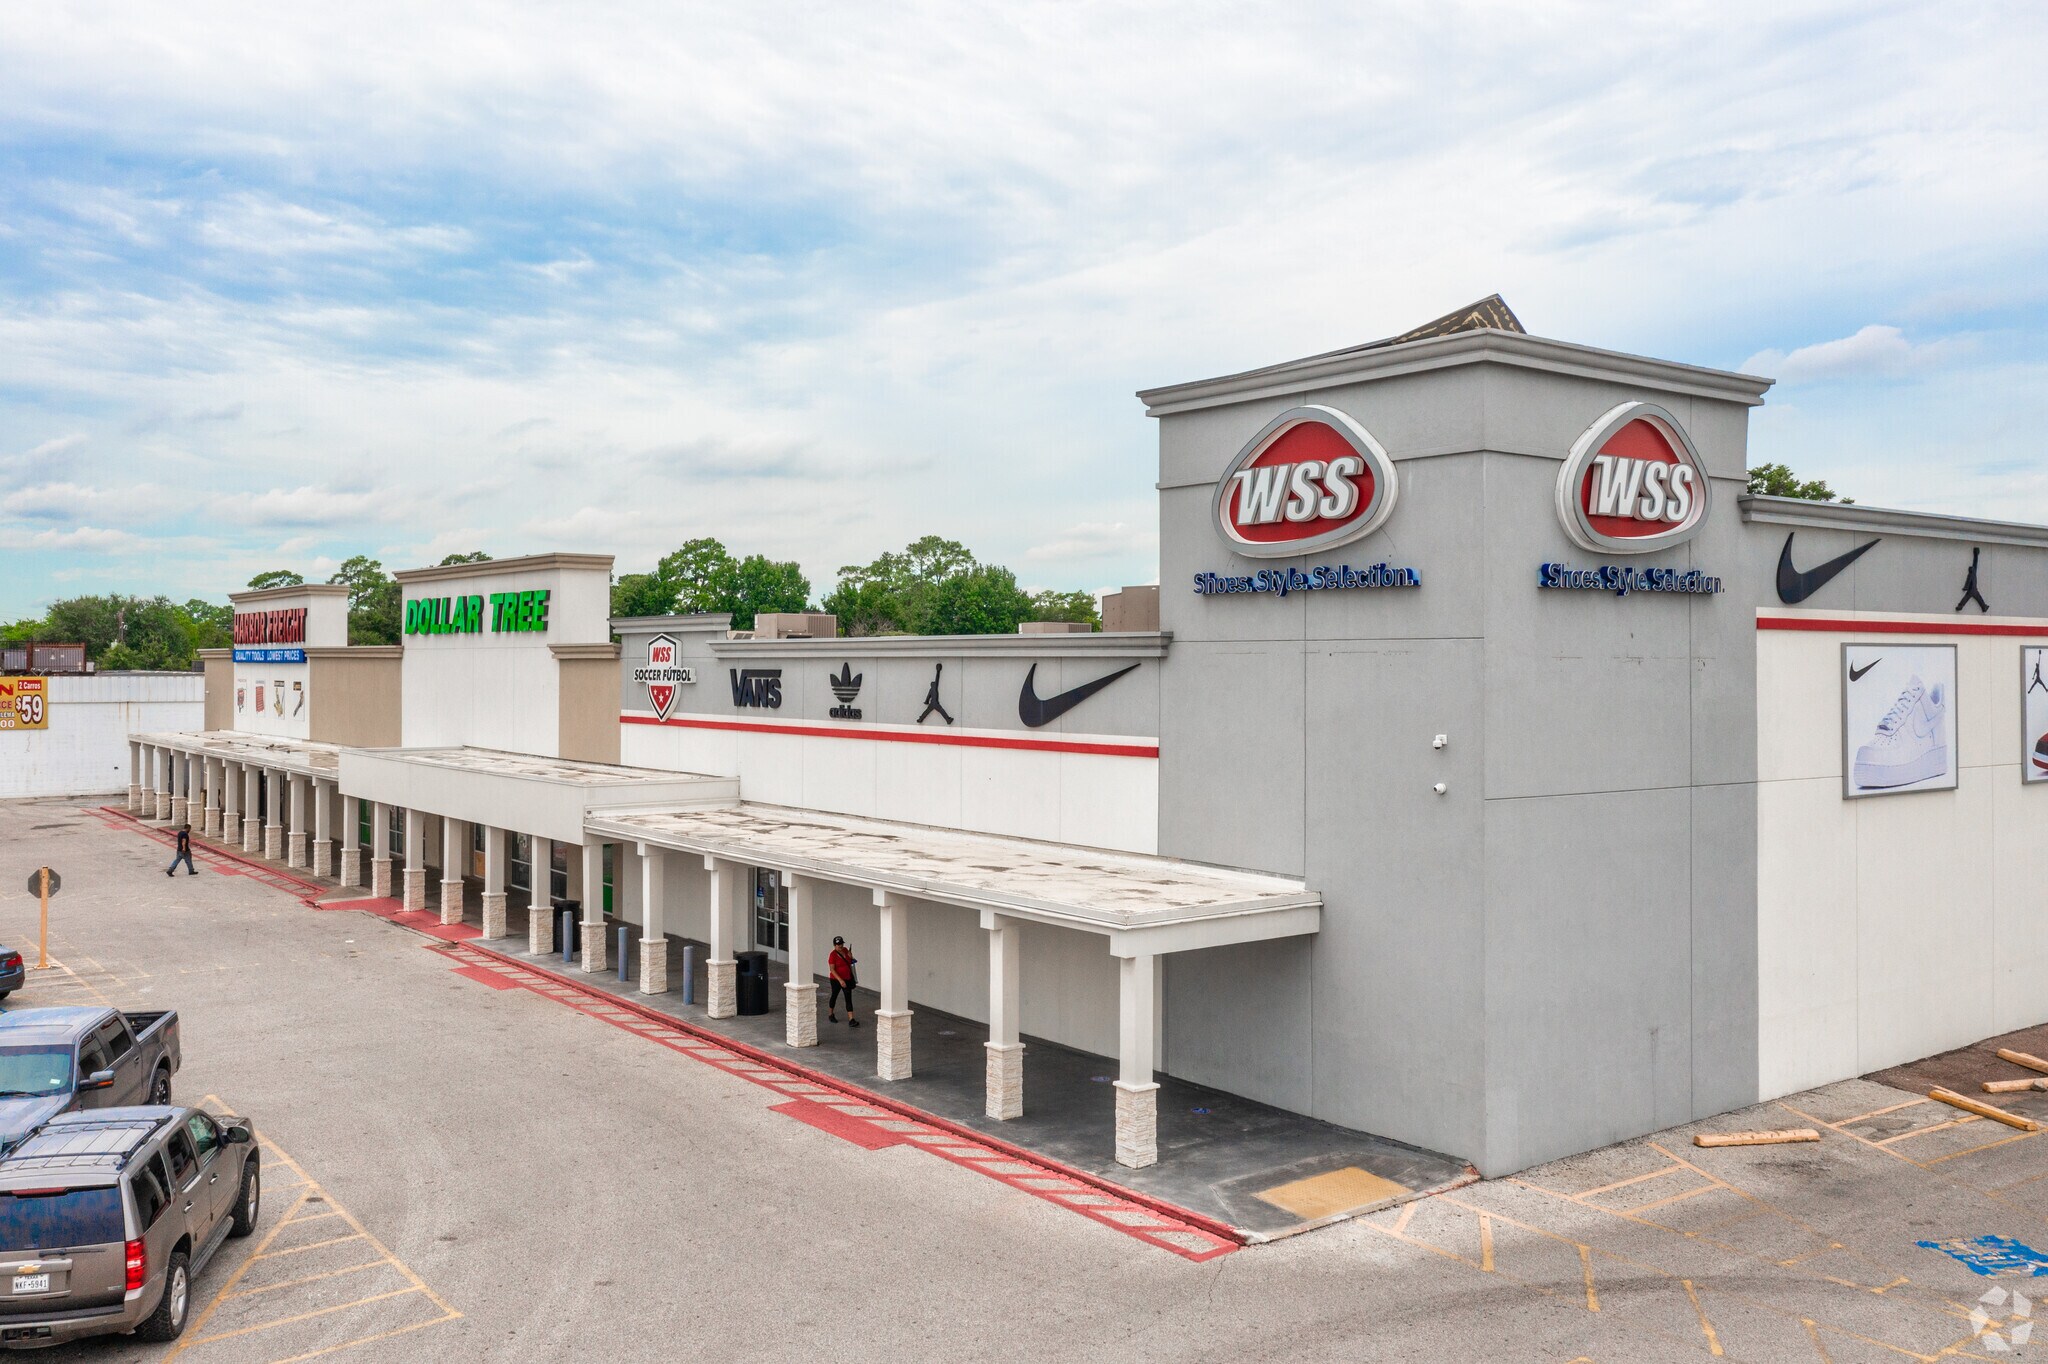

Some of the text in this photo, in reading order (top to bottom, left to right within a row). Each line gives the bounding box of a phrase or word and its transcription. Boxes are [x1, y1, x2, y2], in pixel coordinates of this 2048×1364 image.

[1233, 456, 1364, 526] WSS
[1589, 455, 1695, 523] WSS
[234, 608, 307, 644] HARBOR FREIGHT
[404, 590, 551, 635] DOLLAR TREE
[235, 650, 300, 661] QUALITY TOOLS LOWEST PRICES
[652, 647, 672, 662] WSS
[634, 666, 692, 681] SOCCER FÚTBOL
[729, 668, 782, 709] VANS
[15, 694, 43, 724] $59
[829, 704, 862, 719] adidas
